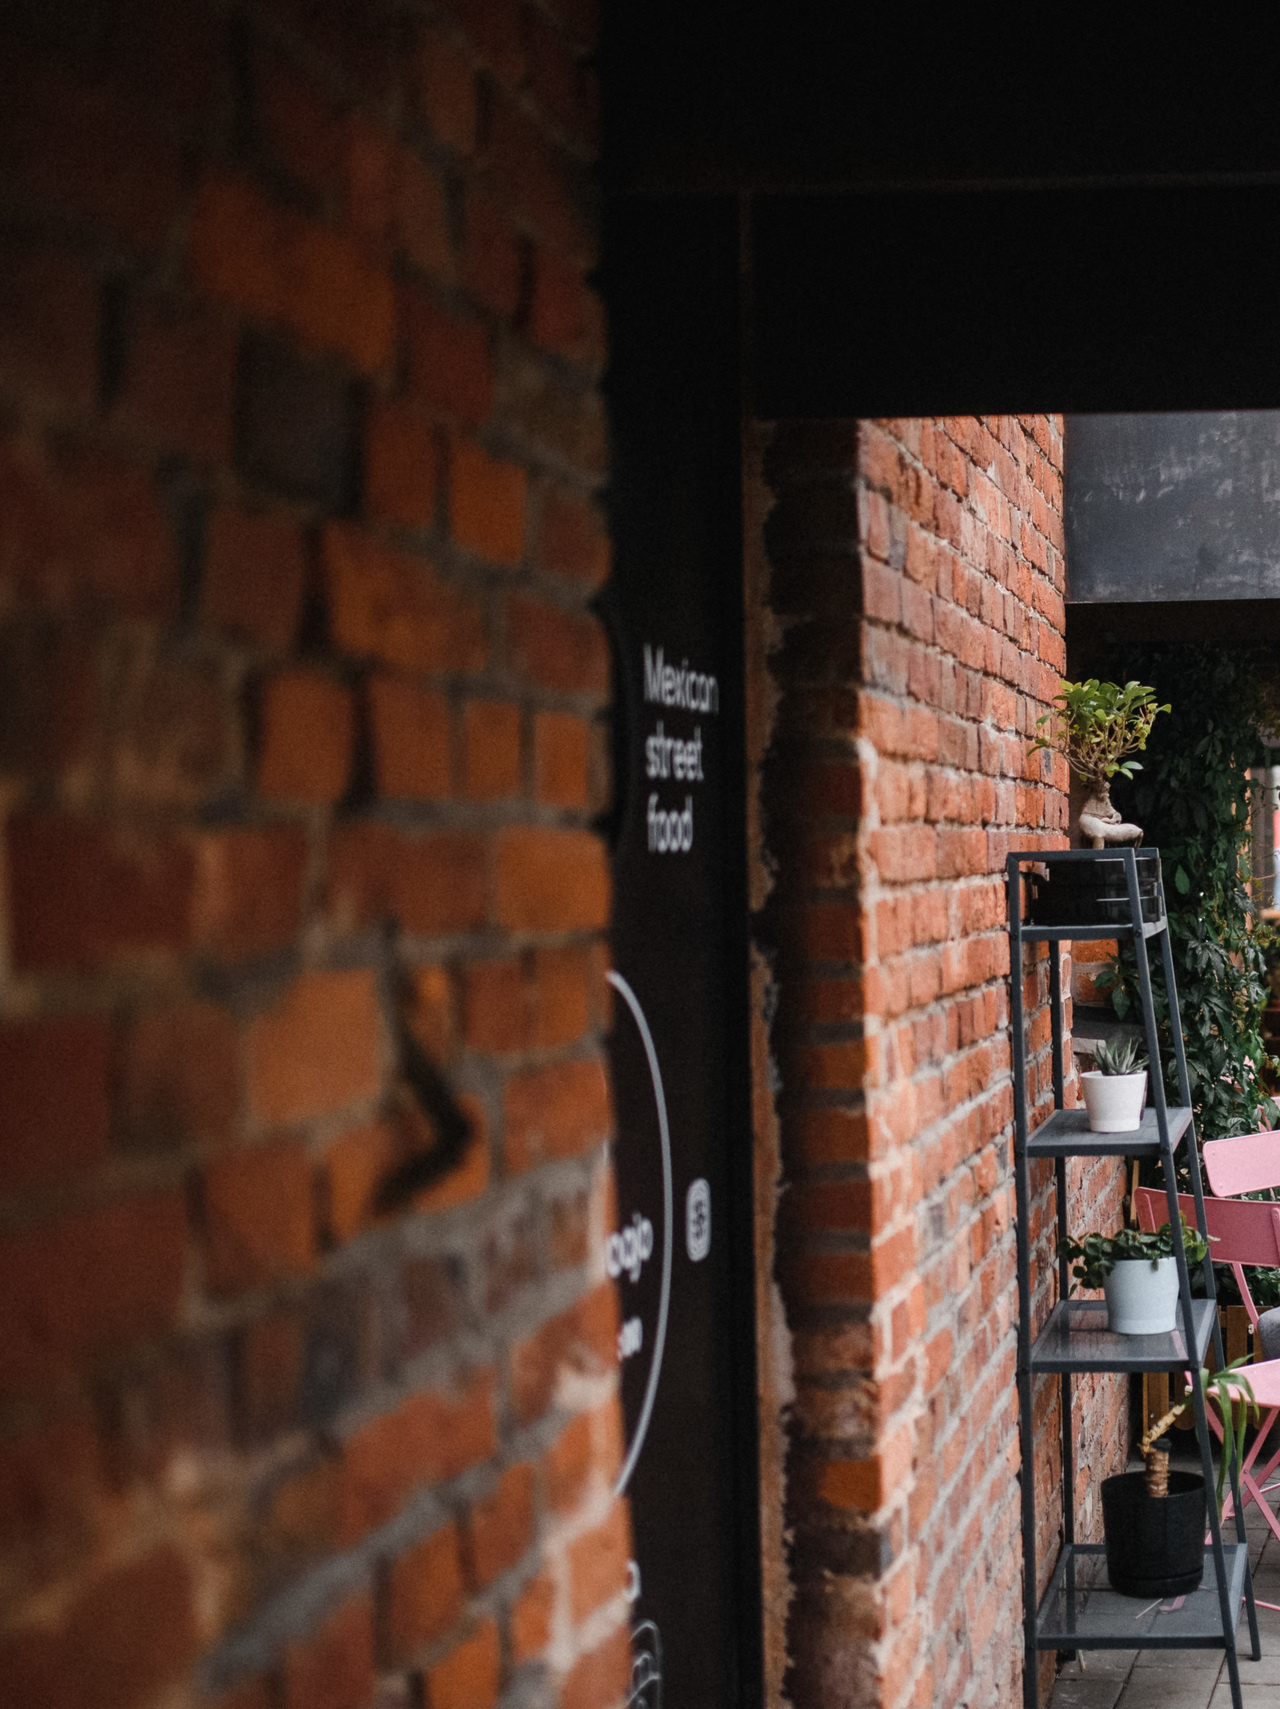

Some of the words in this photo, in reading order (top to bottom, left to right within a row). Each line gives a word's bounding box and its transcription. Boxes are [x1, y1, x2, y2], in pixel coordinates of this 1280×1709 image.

[644, 644, 719, 715] Mexican
[645, 721, 704, 781] street
[647, 792, 693, 854] food
